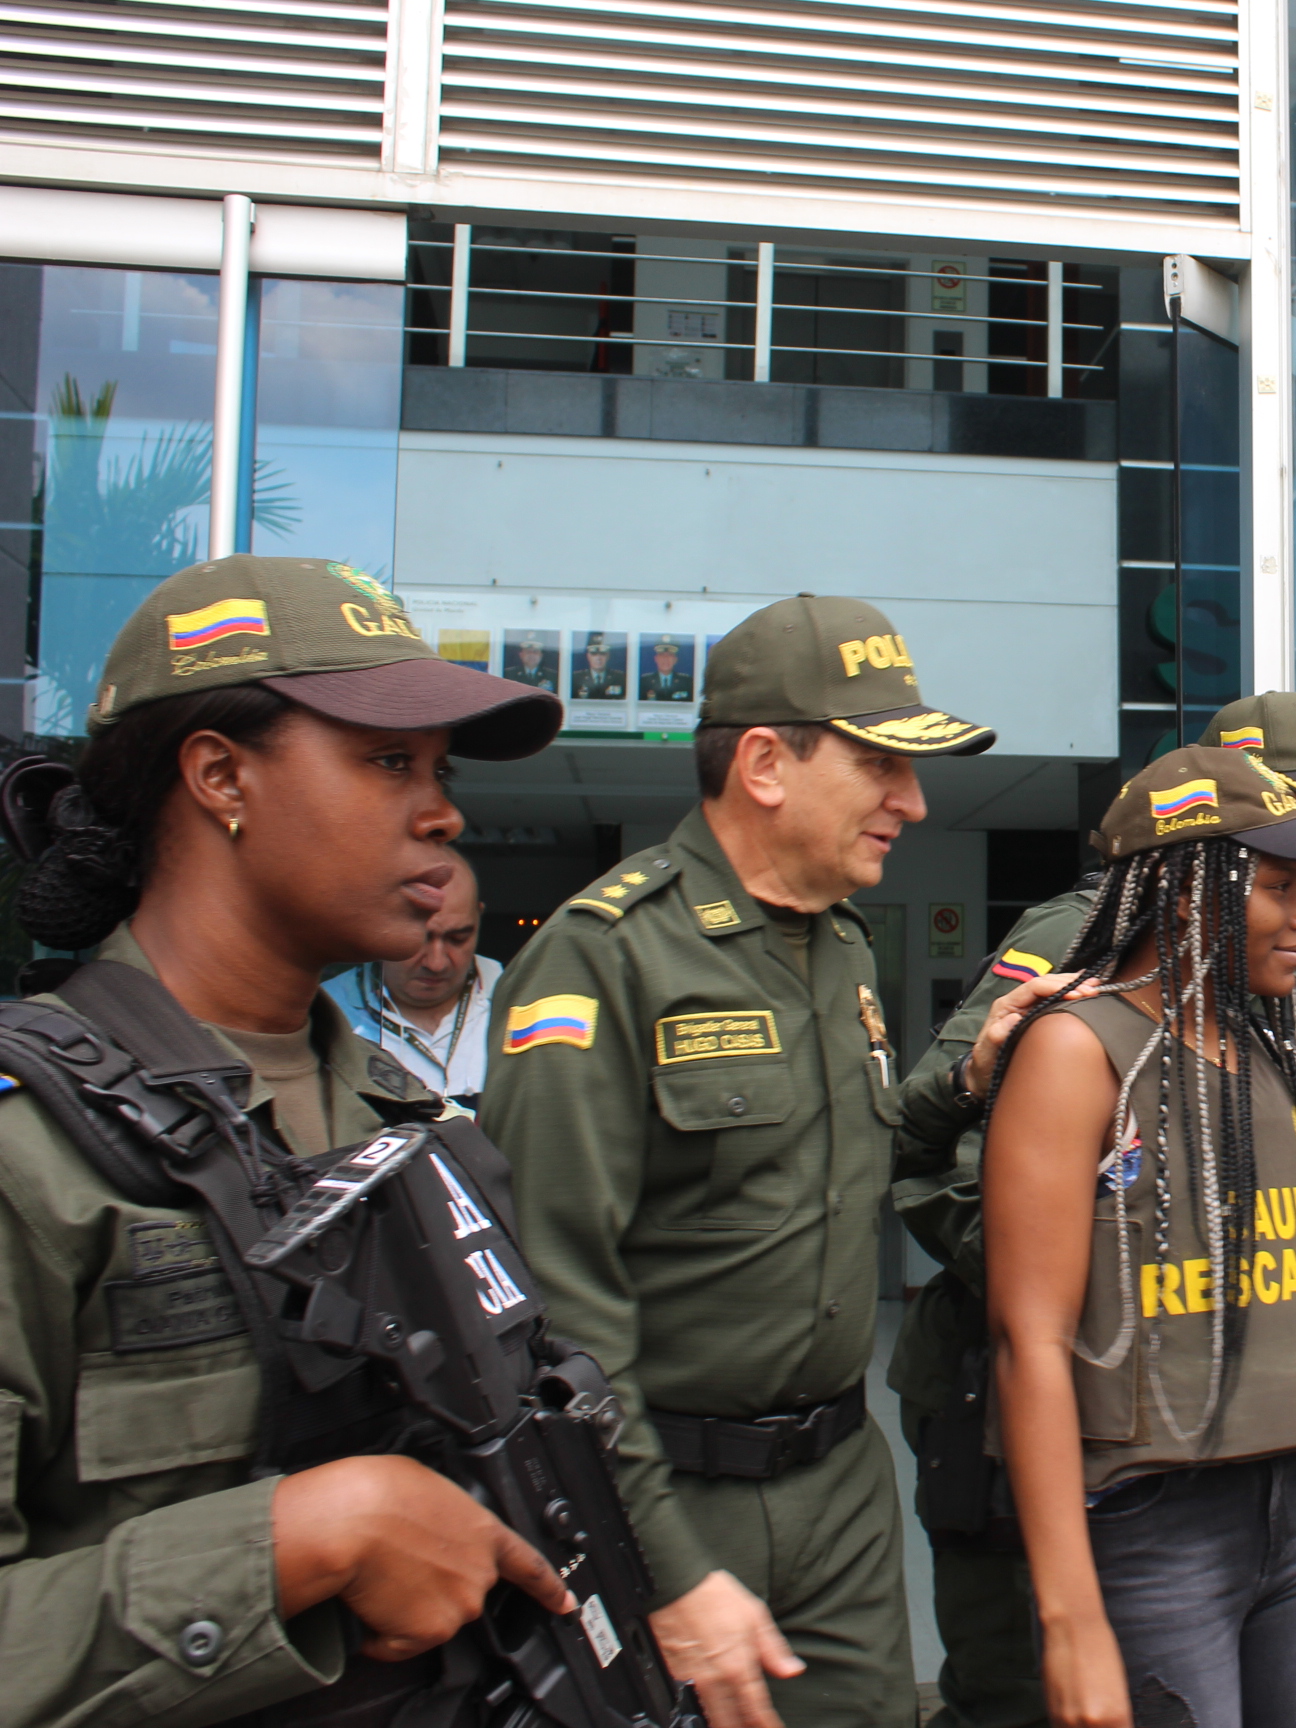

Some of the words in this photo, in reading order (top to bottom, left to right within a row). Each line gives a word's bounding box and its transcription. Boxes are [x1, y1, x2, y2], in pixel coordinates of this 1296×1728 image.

[1155, 812, 1222, 836] Colombia
[674, 1035, 719, 1055] HUGO
[362, 1141, 390, 1160] 2
